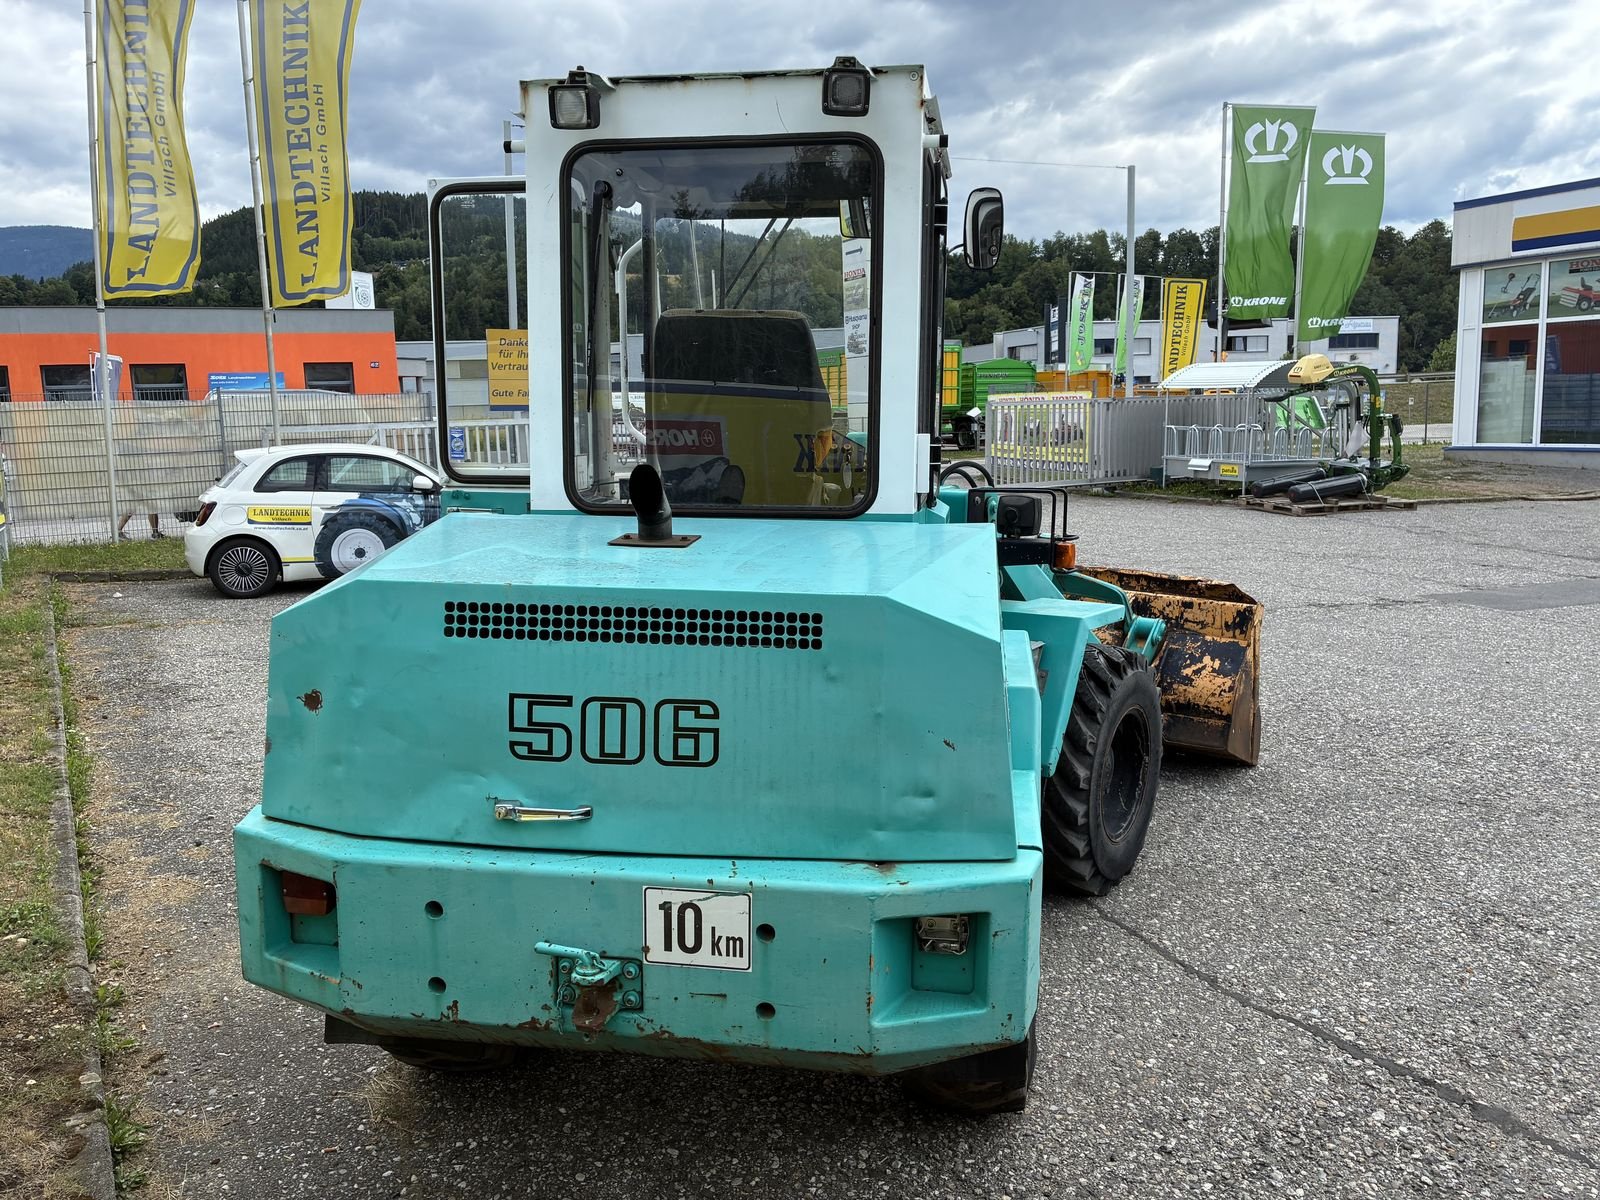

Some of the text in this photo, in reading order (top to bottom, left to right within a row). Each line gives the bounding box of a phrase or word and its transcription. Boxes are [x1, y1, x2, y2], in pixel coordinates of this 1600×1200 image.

[152, 71, 176, 197] Villach GmbH
[282, 0, 321, 286] LANDTECHNIK
[312, 84, 331, 202] Villach GmbH
[844, 267, 865, 278] HONDA
[1243, 296, 1287, 307] KRONE
[1168, 284, 1188, 374] ANDTECHNIK
[499, 337, 528, 347] Danke
[499, 349, 513, 359] für
[491, 362, 528, 371] Vertrau
[1339, 367, 1358, 376] KRONE
[492, 389, 529, 398] Gute Fa
[253, 508, 310, 517] LANDTECHNIK
[509, 692, 720, 768] 506
[658, 900, 744, 959] 10 km
